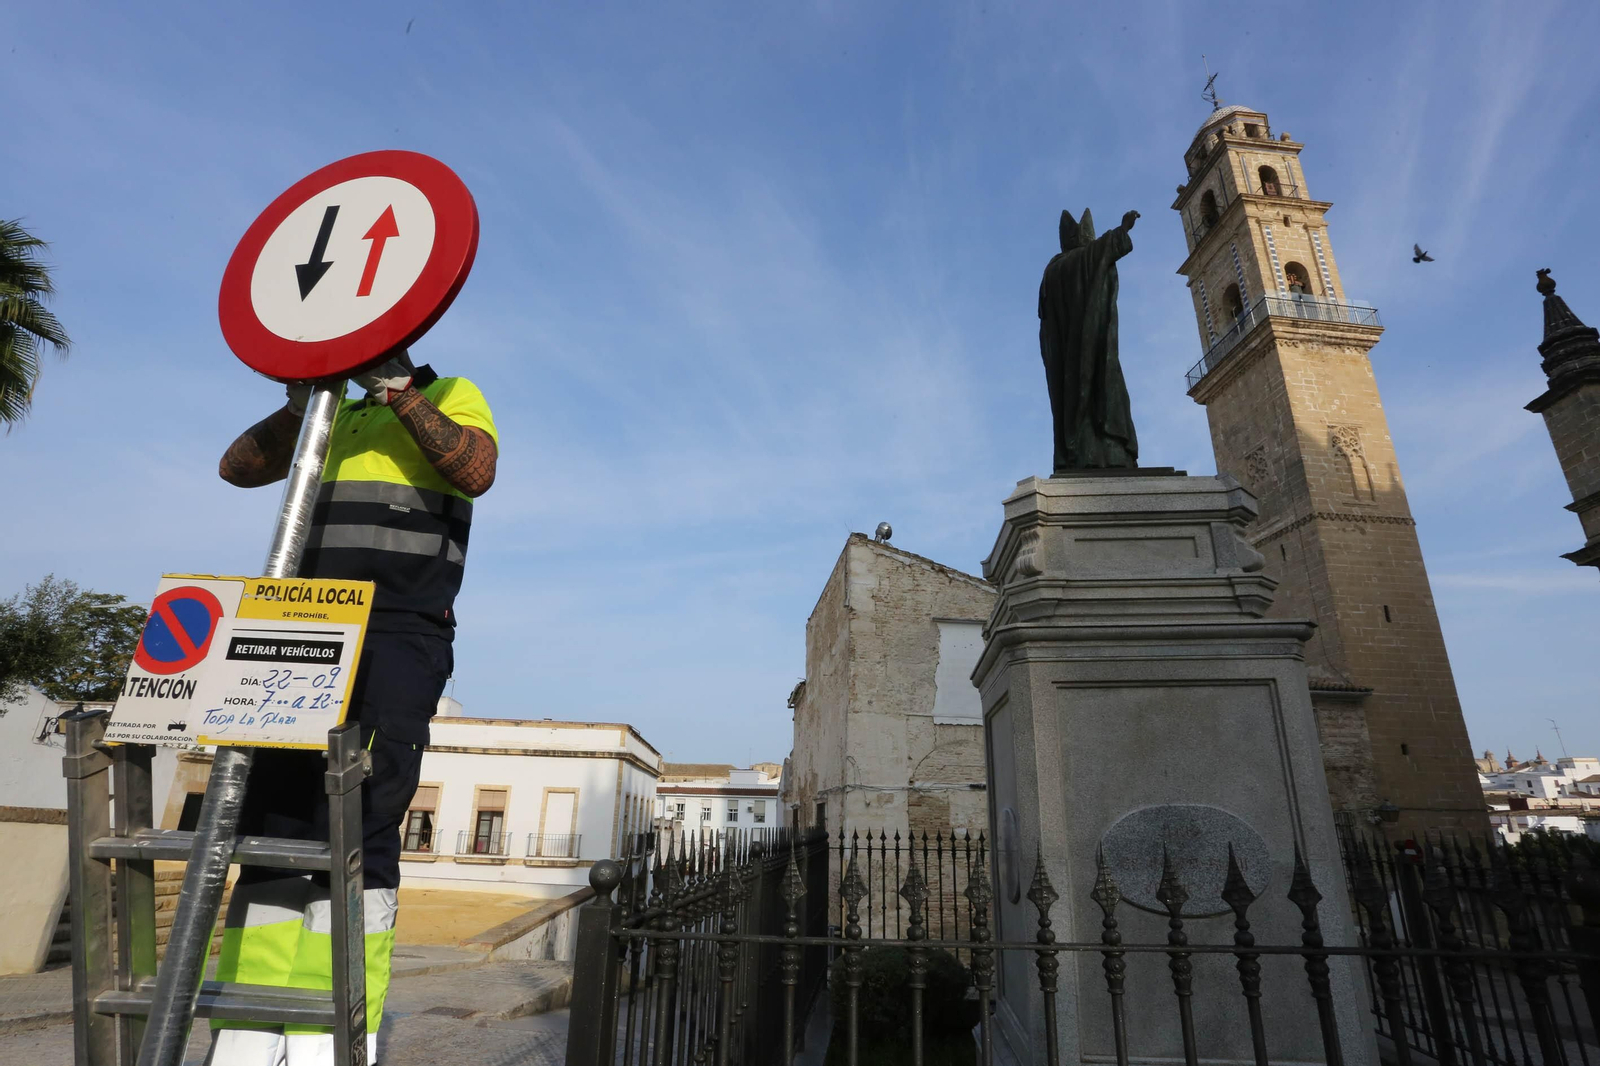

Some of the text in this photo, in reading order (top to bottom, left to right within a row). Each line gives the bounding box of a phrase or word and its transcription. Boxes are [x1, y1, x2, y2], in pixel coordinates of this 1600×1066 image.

[254, 582, 364, 606] POLICÍA LOCAL
[235, 644, 335, 658] RETIRAR VEHÍCULOS
[240, 676, 261, 686] DÍA:
[223, 697, 258, 706] HORA:
